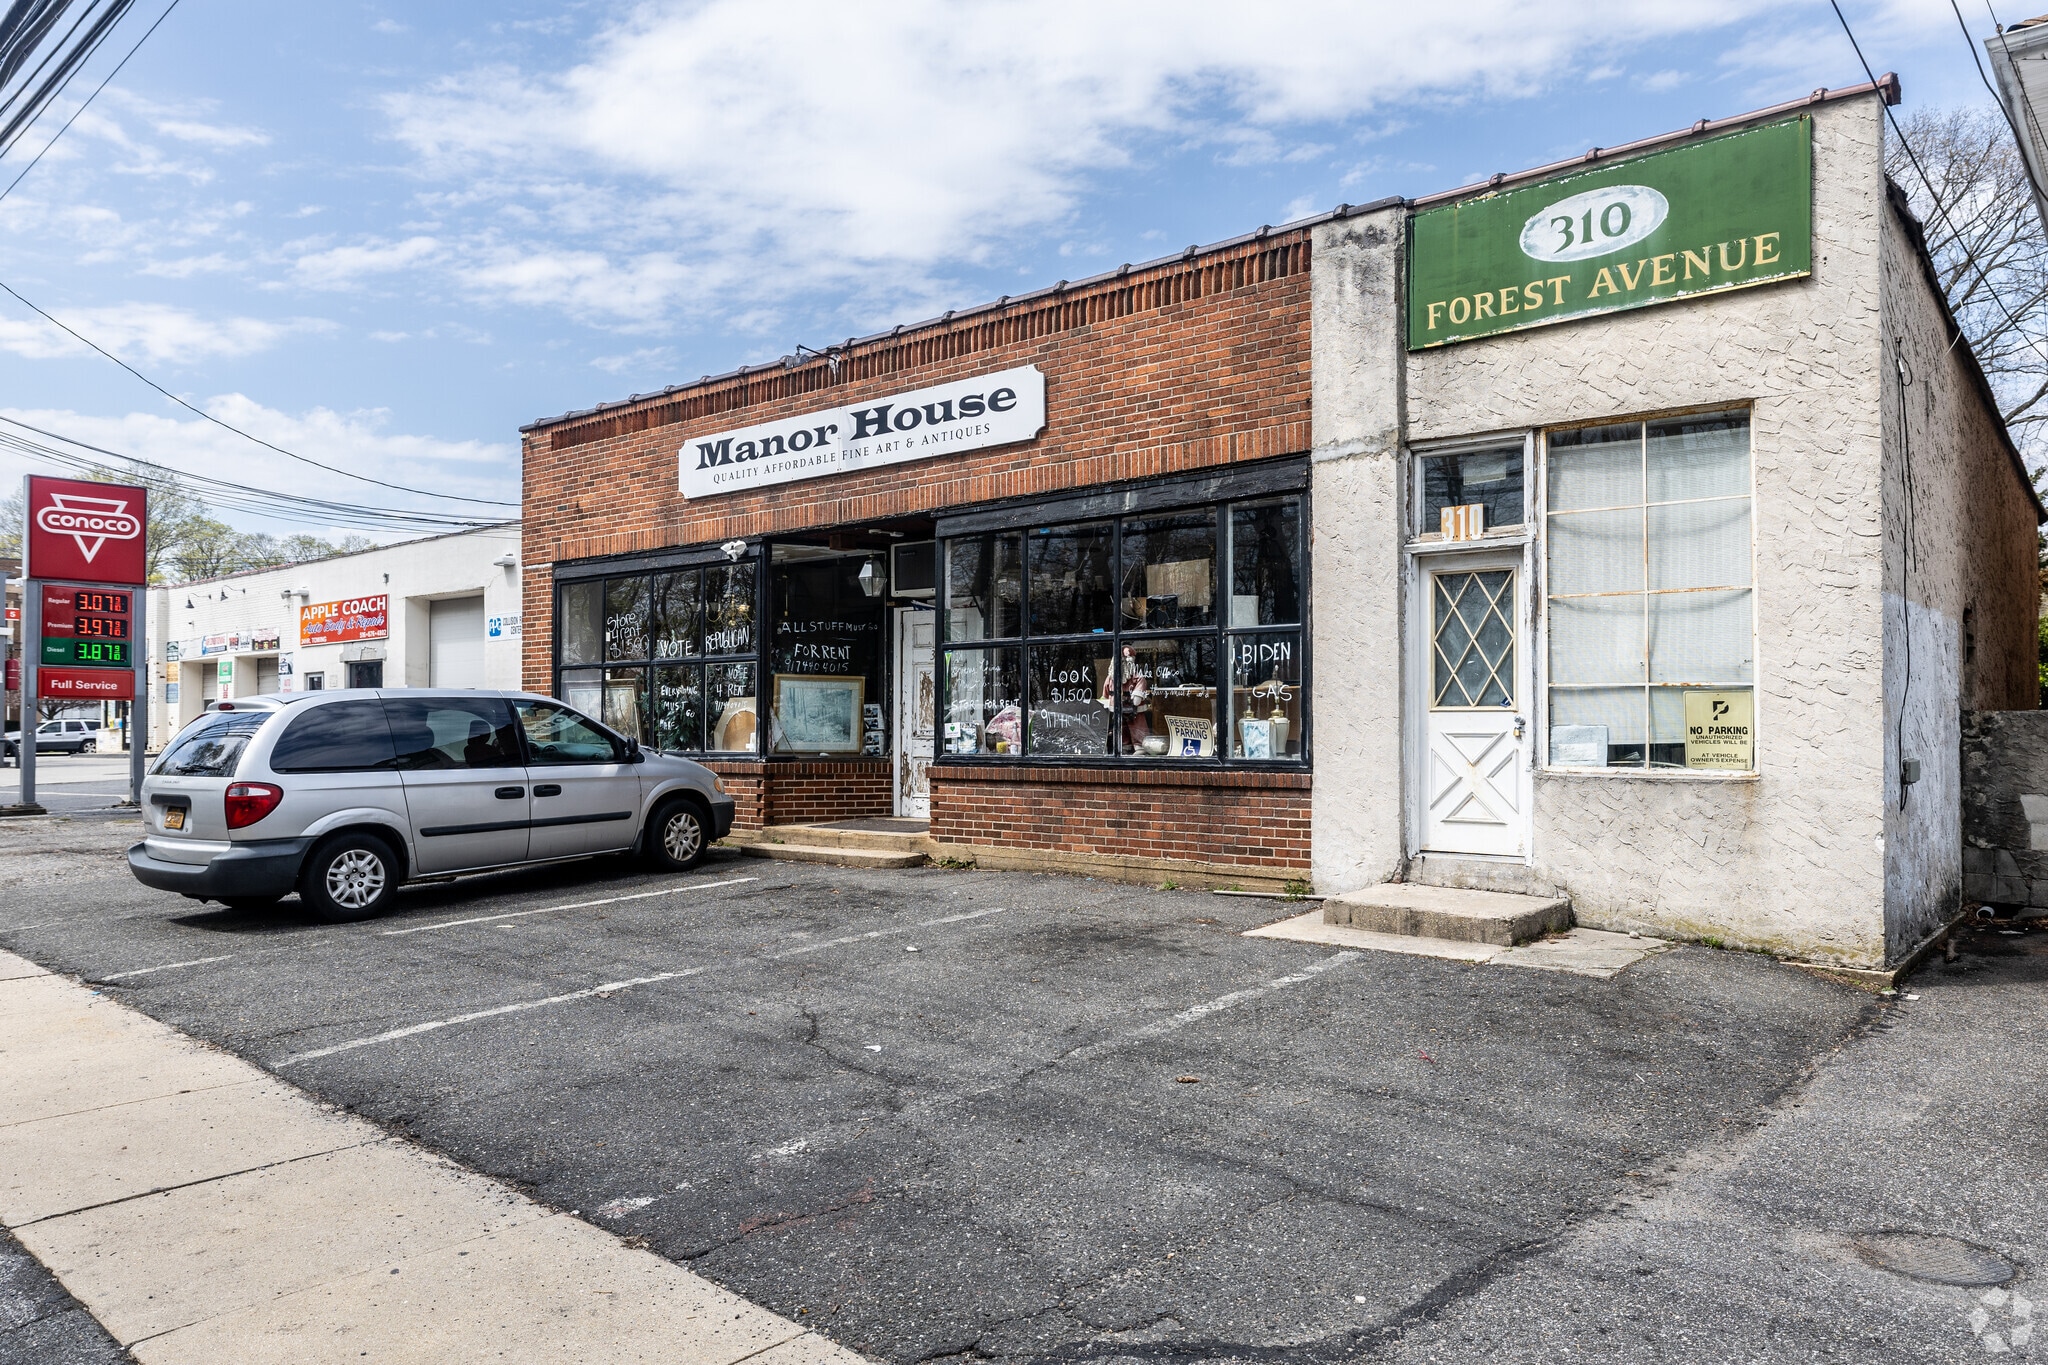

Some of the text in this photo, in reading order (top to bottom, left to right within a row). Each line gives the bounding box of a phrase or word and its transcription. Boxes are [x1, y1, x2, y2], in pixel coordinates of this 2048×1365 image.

[1550, 202, 1632, 254] 310
[1427, 232, 1781, 330] FOREST AVENUE
[695, 388, 1017, 471] Manor House
[713, 423, 991, 484] QUALITY AFFORDABLE FINE ART & ANTIQUES
[1441, 505, 1484, 541] 310
[48, 597, 71, 605] Regular
[302, 597, 386, 620] APPLE COACH
[303, 622, 323, 635] Auto
[324, 618, 345, 635] Body
[355, 612, 385, 631] Repair
[607, 612, 636, 633] Store
[611, 623, 642, 642] 4 rent
[660, 639, 693, 657] VOTE
[1242, 642, 1290, 665] BIDEN
[1049, 666, 1092, 683] LOOK
[51, 680, 118, 690] Full Service
[716, 683, 746, 697] 4 RENT
[1252, 684, 1293, 701] GAS
[1169, 719, 1209, 730] RESERVED
[1175, 728, 1208, 740] PARKING
[1690, 726, 1748, 735] NO PARKING
